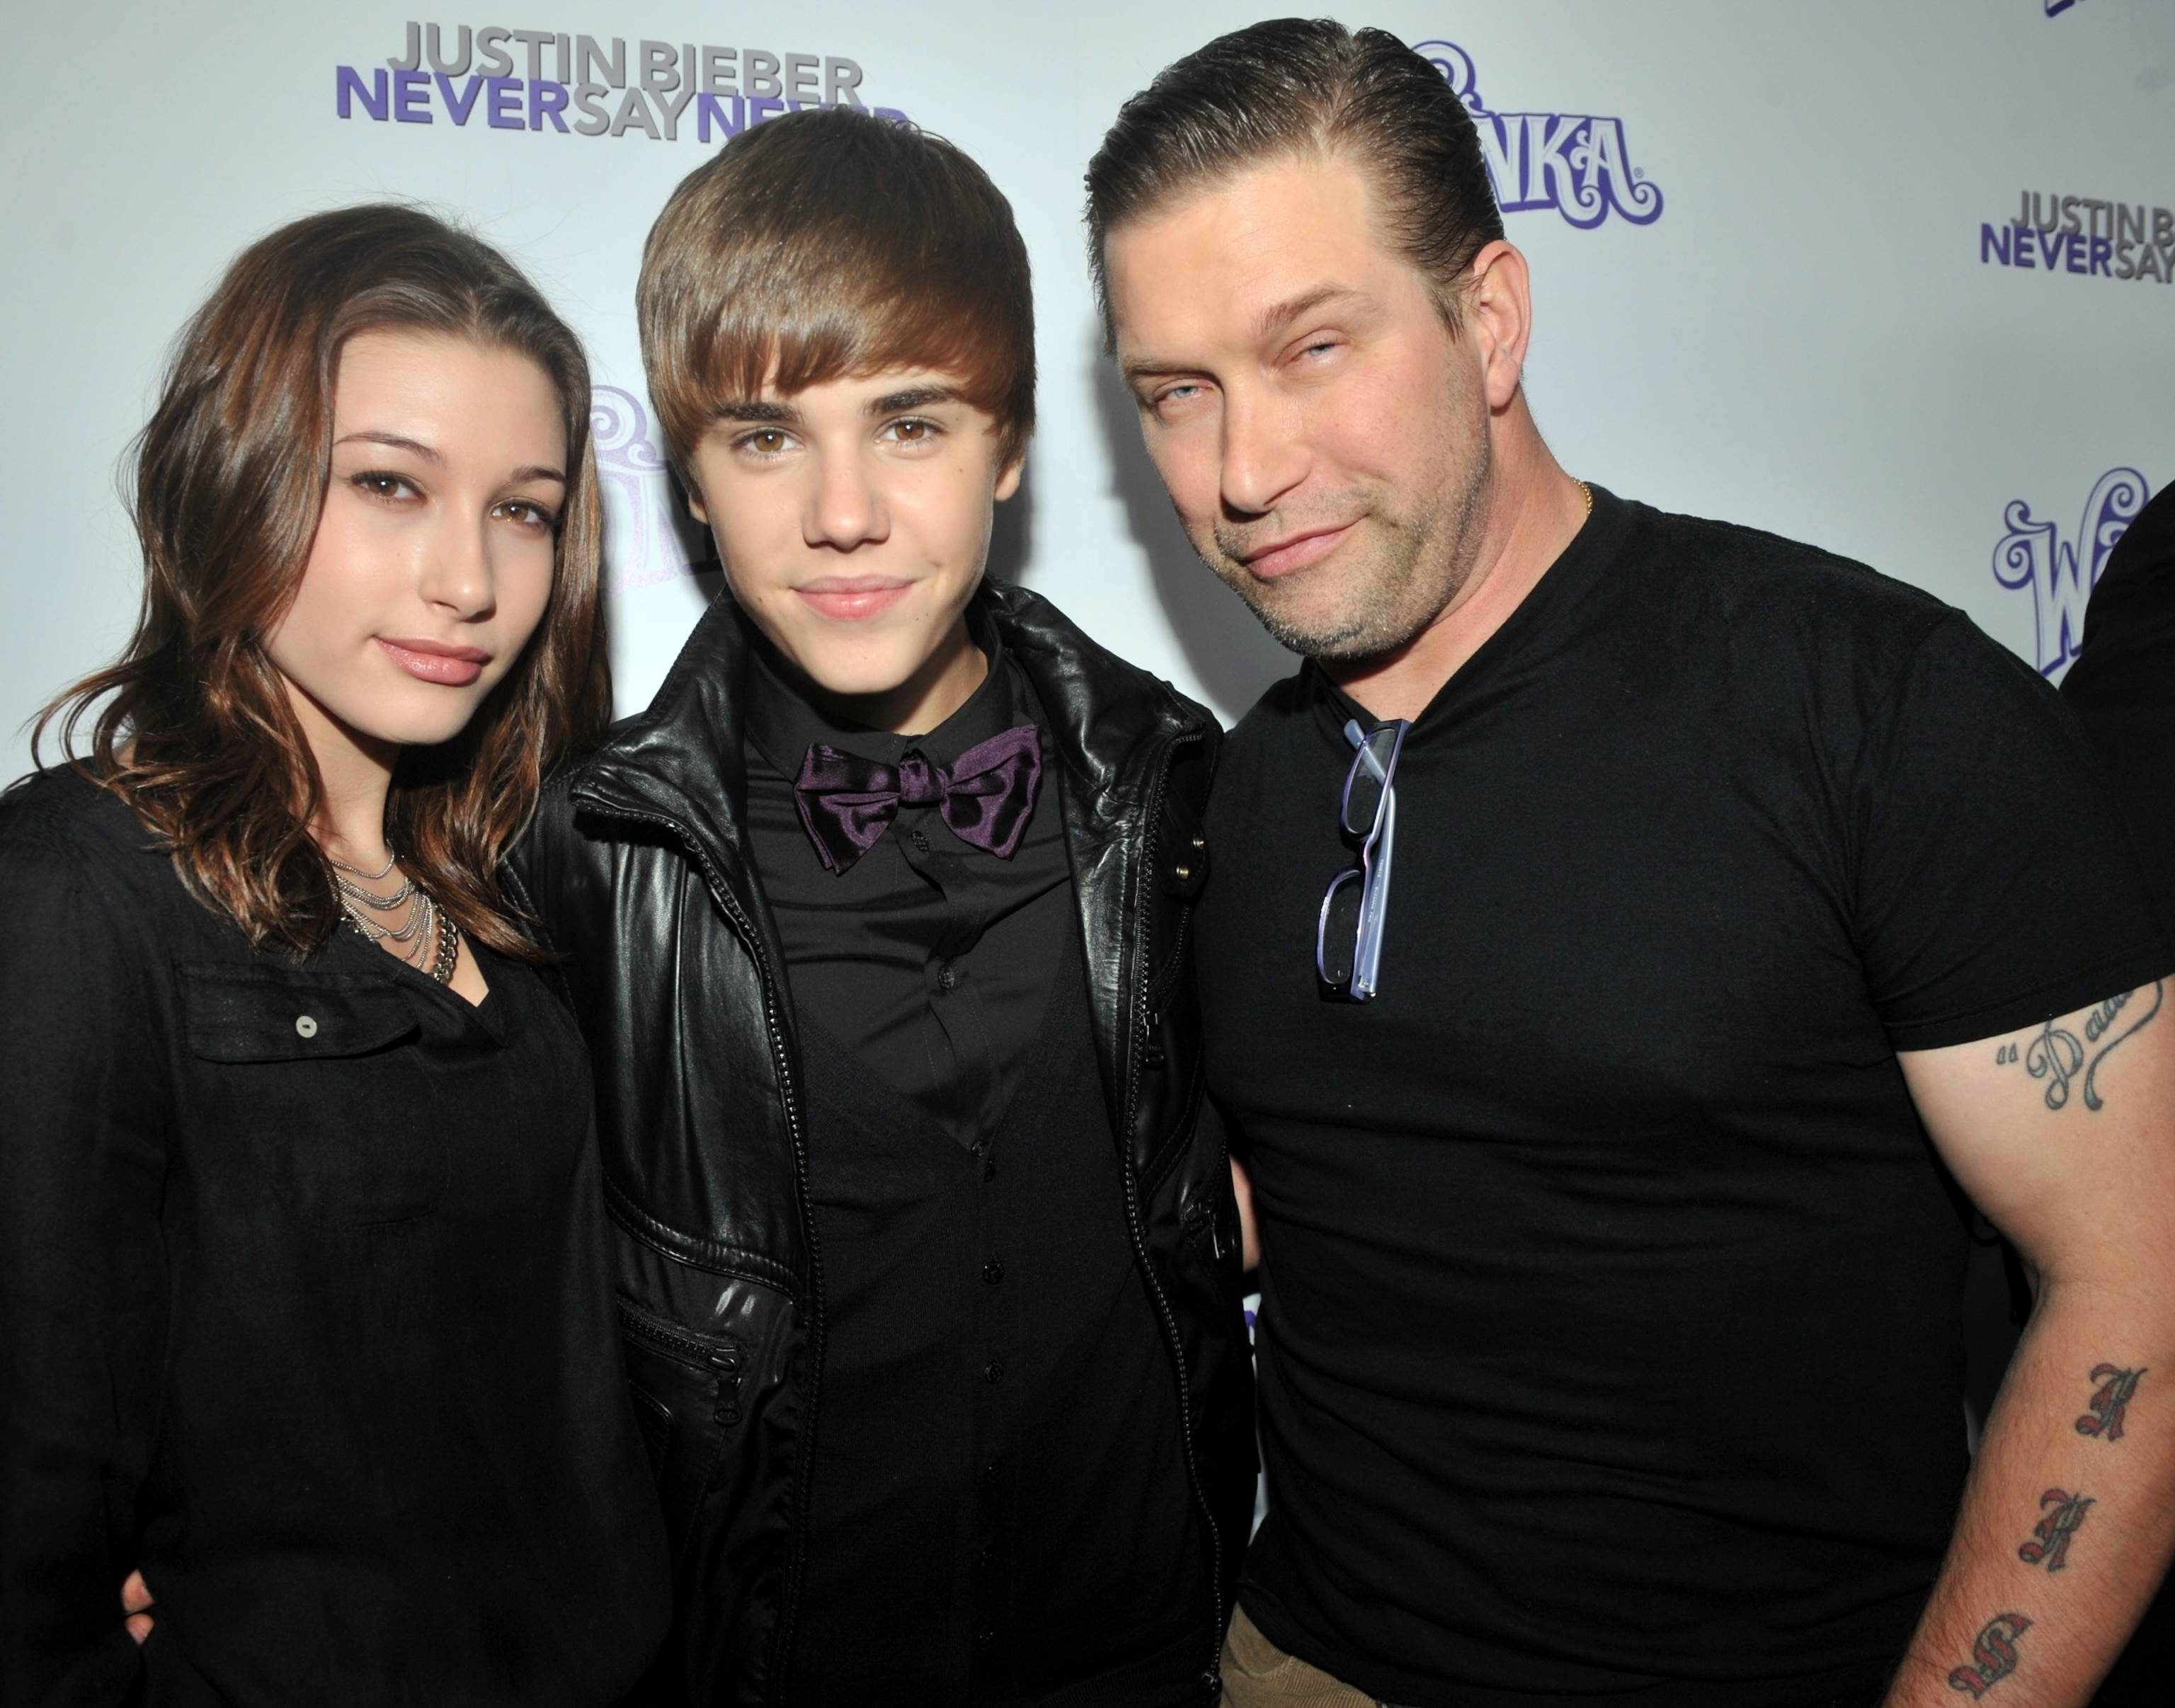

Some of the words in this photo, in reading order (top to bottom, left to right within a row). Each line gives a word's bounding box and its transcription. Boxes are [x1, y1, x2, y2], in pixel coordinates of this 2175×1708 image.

[387, 21, 626, 89] JUSTIN
[639, 40, 864, 105] BIEBER
[336, 65, 571, 134] NEVER
[2011, 190, 2145, 244] JUSTIN
[1980, 223, 2113, 277] NEVER
